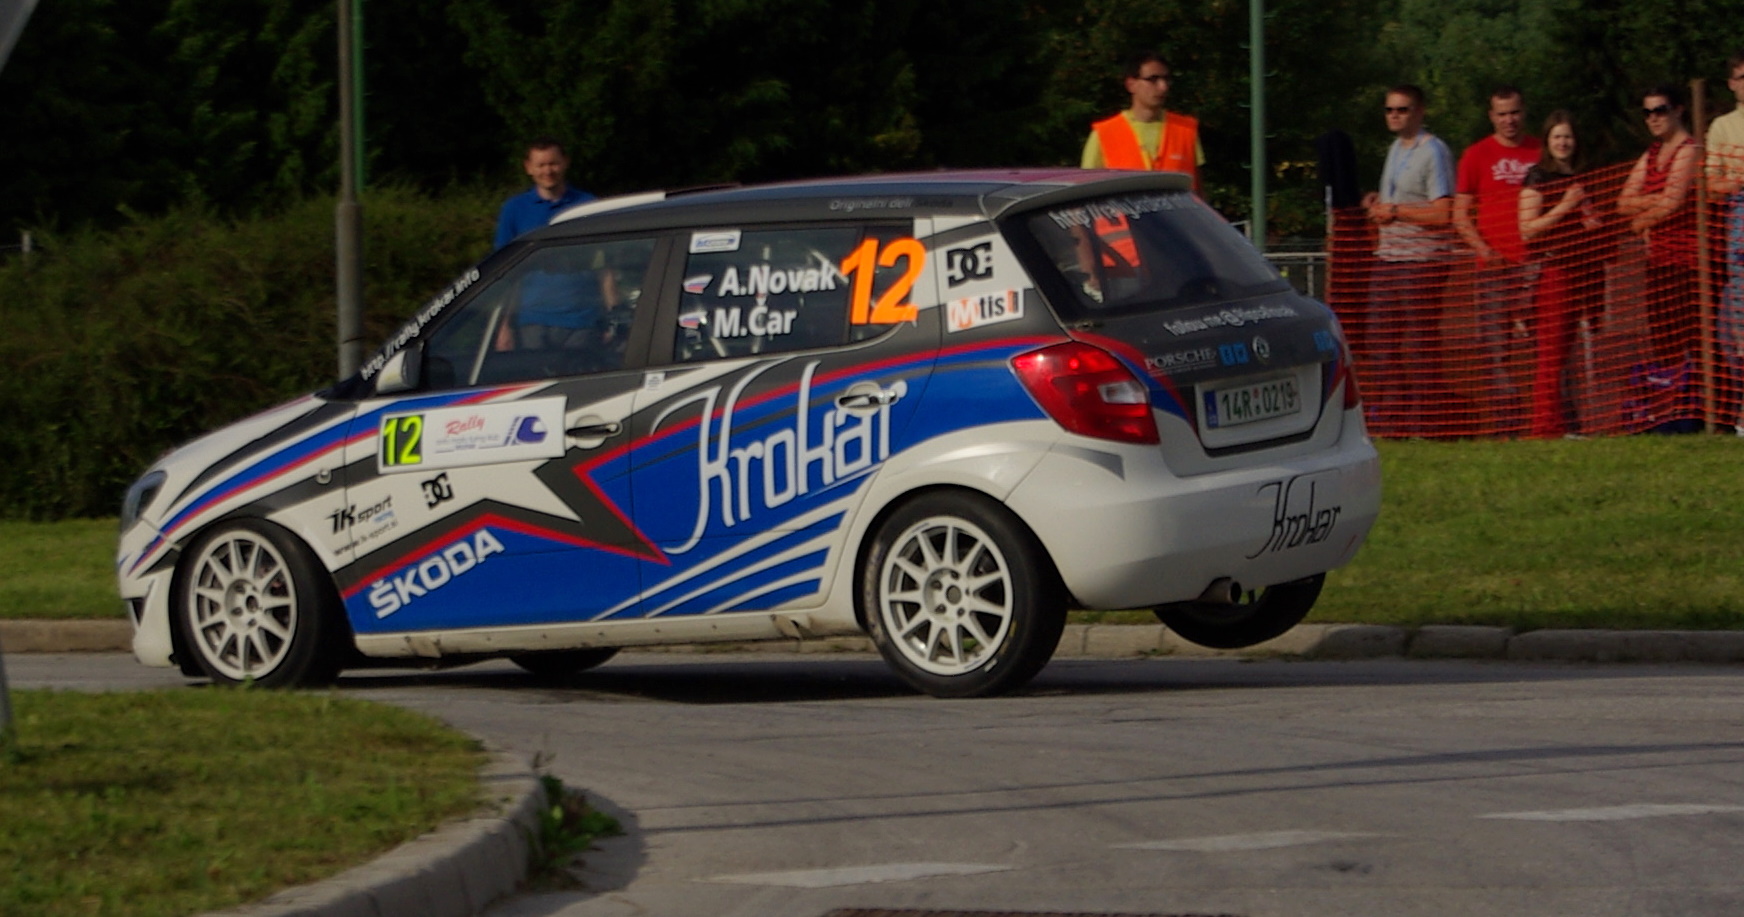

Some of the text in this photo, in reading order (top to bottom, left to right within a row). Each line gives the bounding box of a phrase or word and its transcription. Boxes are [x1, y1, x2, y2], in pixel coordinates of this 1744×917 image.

[718, 264, 836, 298] A.Novak
[840, 237, 927, 325] 12
[383, 414, 424, 466] 12
[650, 355, 908, 555] Krokar
[368, 528, 505, 620] ŠKODA
